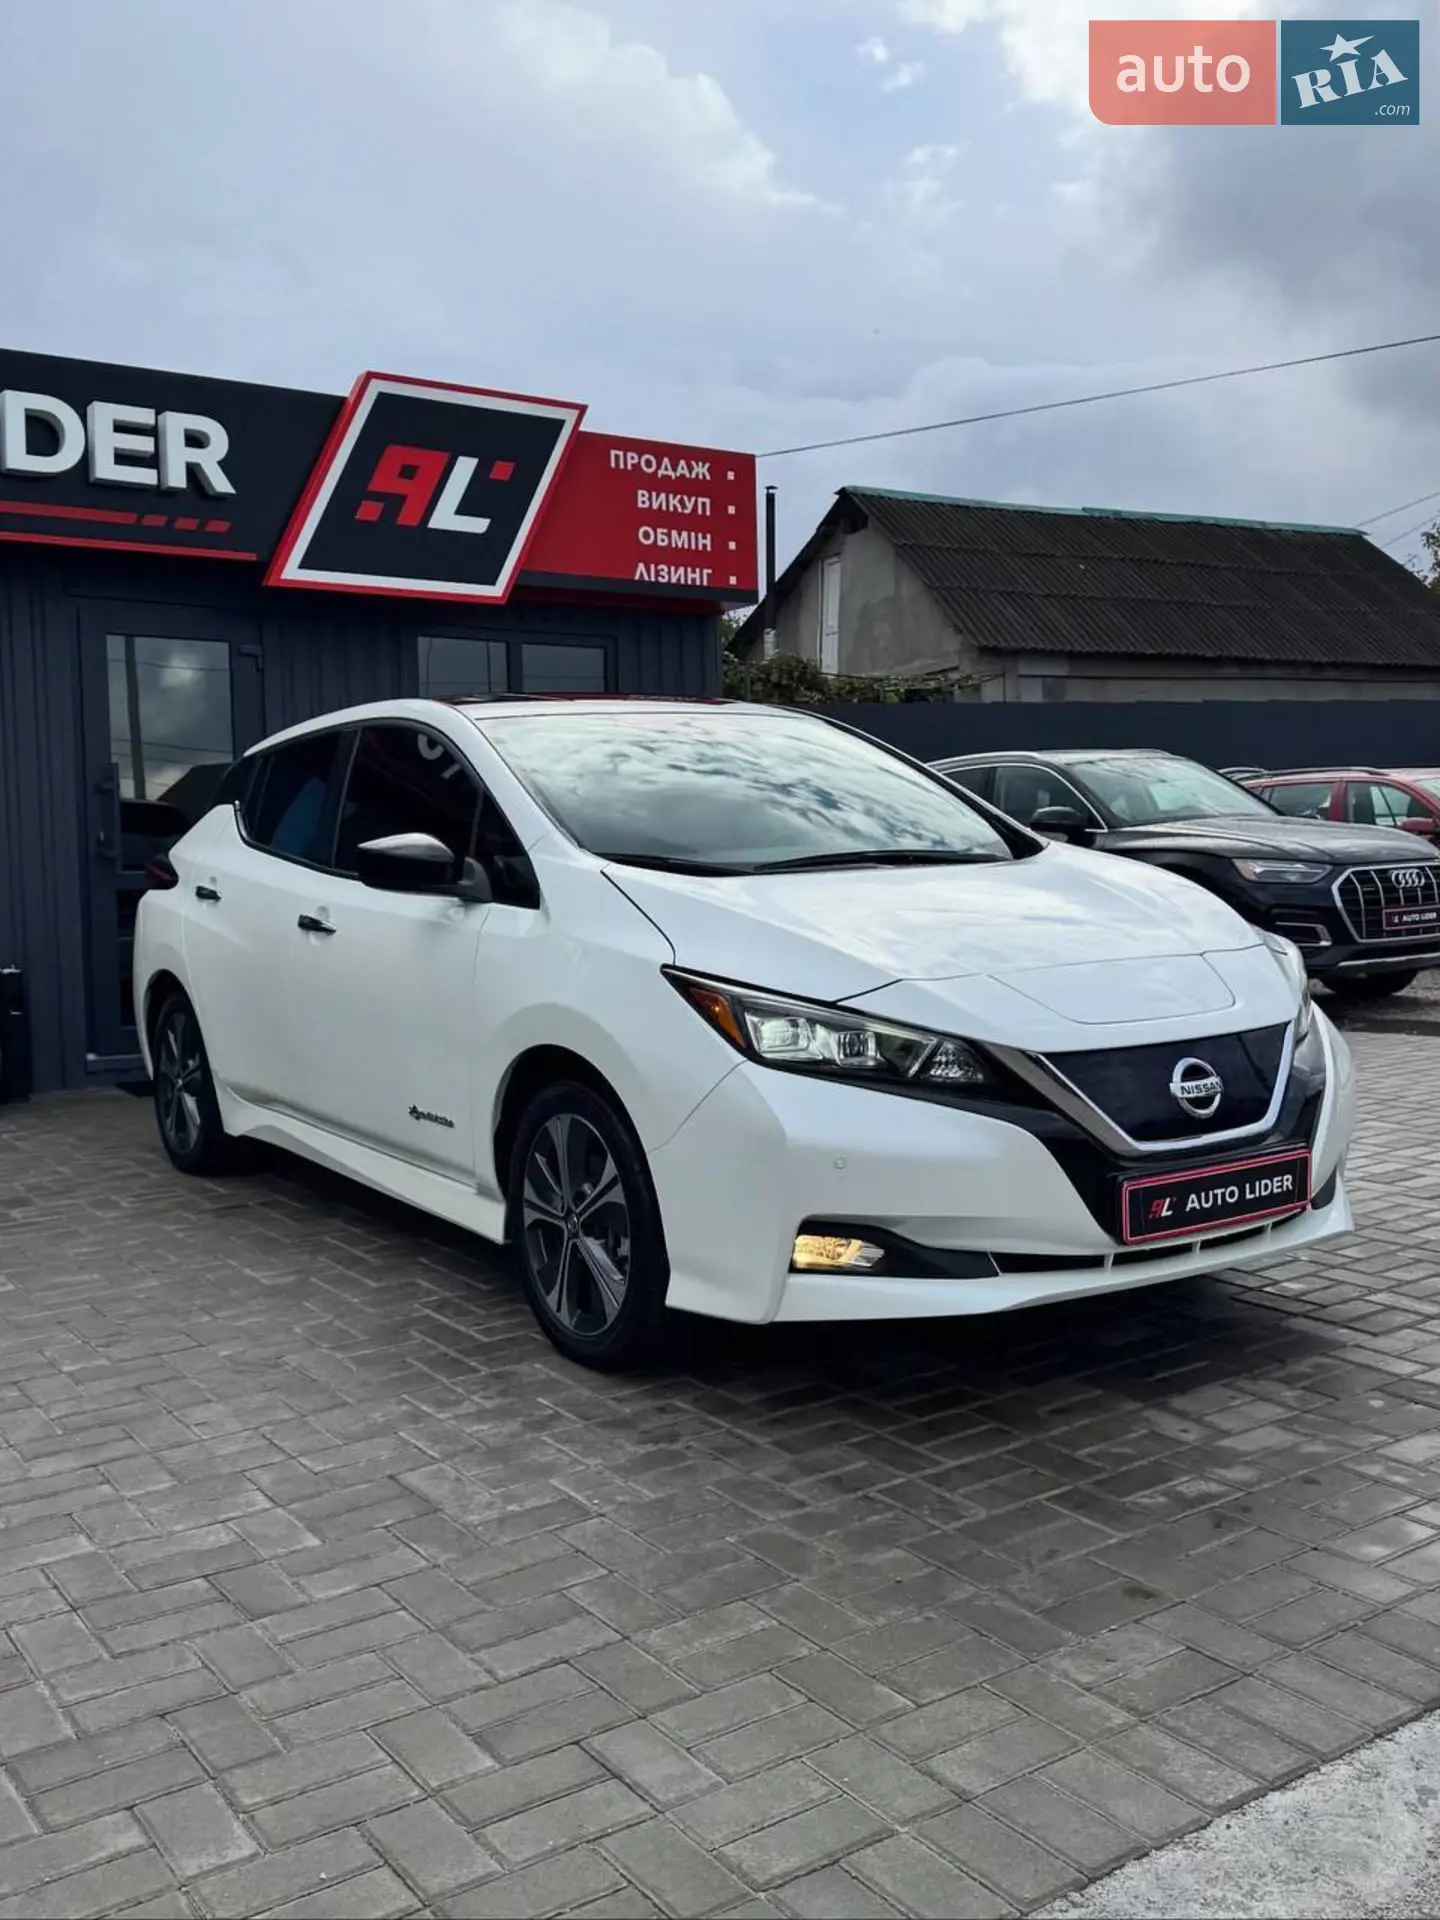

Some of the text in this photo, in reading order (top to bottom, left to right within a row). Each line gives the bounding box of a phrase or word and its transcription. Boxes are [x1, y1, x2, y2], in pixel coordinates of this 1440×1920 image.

[0, 389, 236, 496] DER
[609, 449, 712, 481] ПРОДАЖ
[636, 489, 712, 517] ВИКУП
[638, 526, 712, 551] ОБМІН
[634, 562, 713, 586] ЛІЗИНГ
[1180, 1080, 1222, 1096] NISSAN
[1185, 1186, 1239, 1212] AUTO
[1245, 1174, 1293, 1200] LIDER
